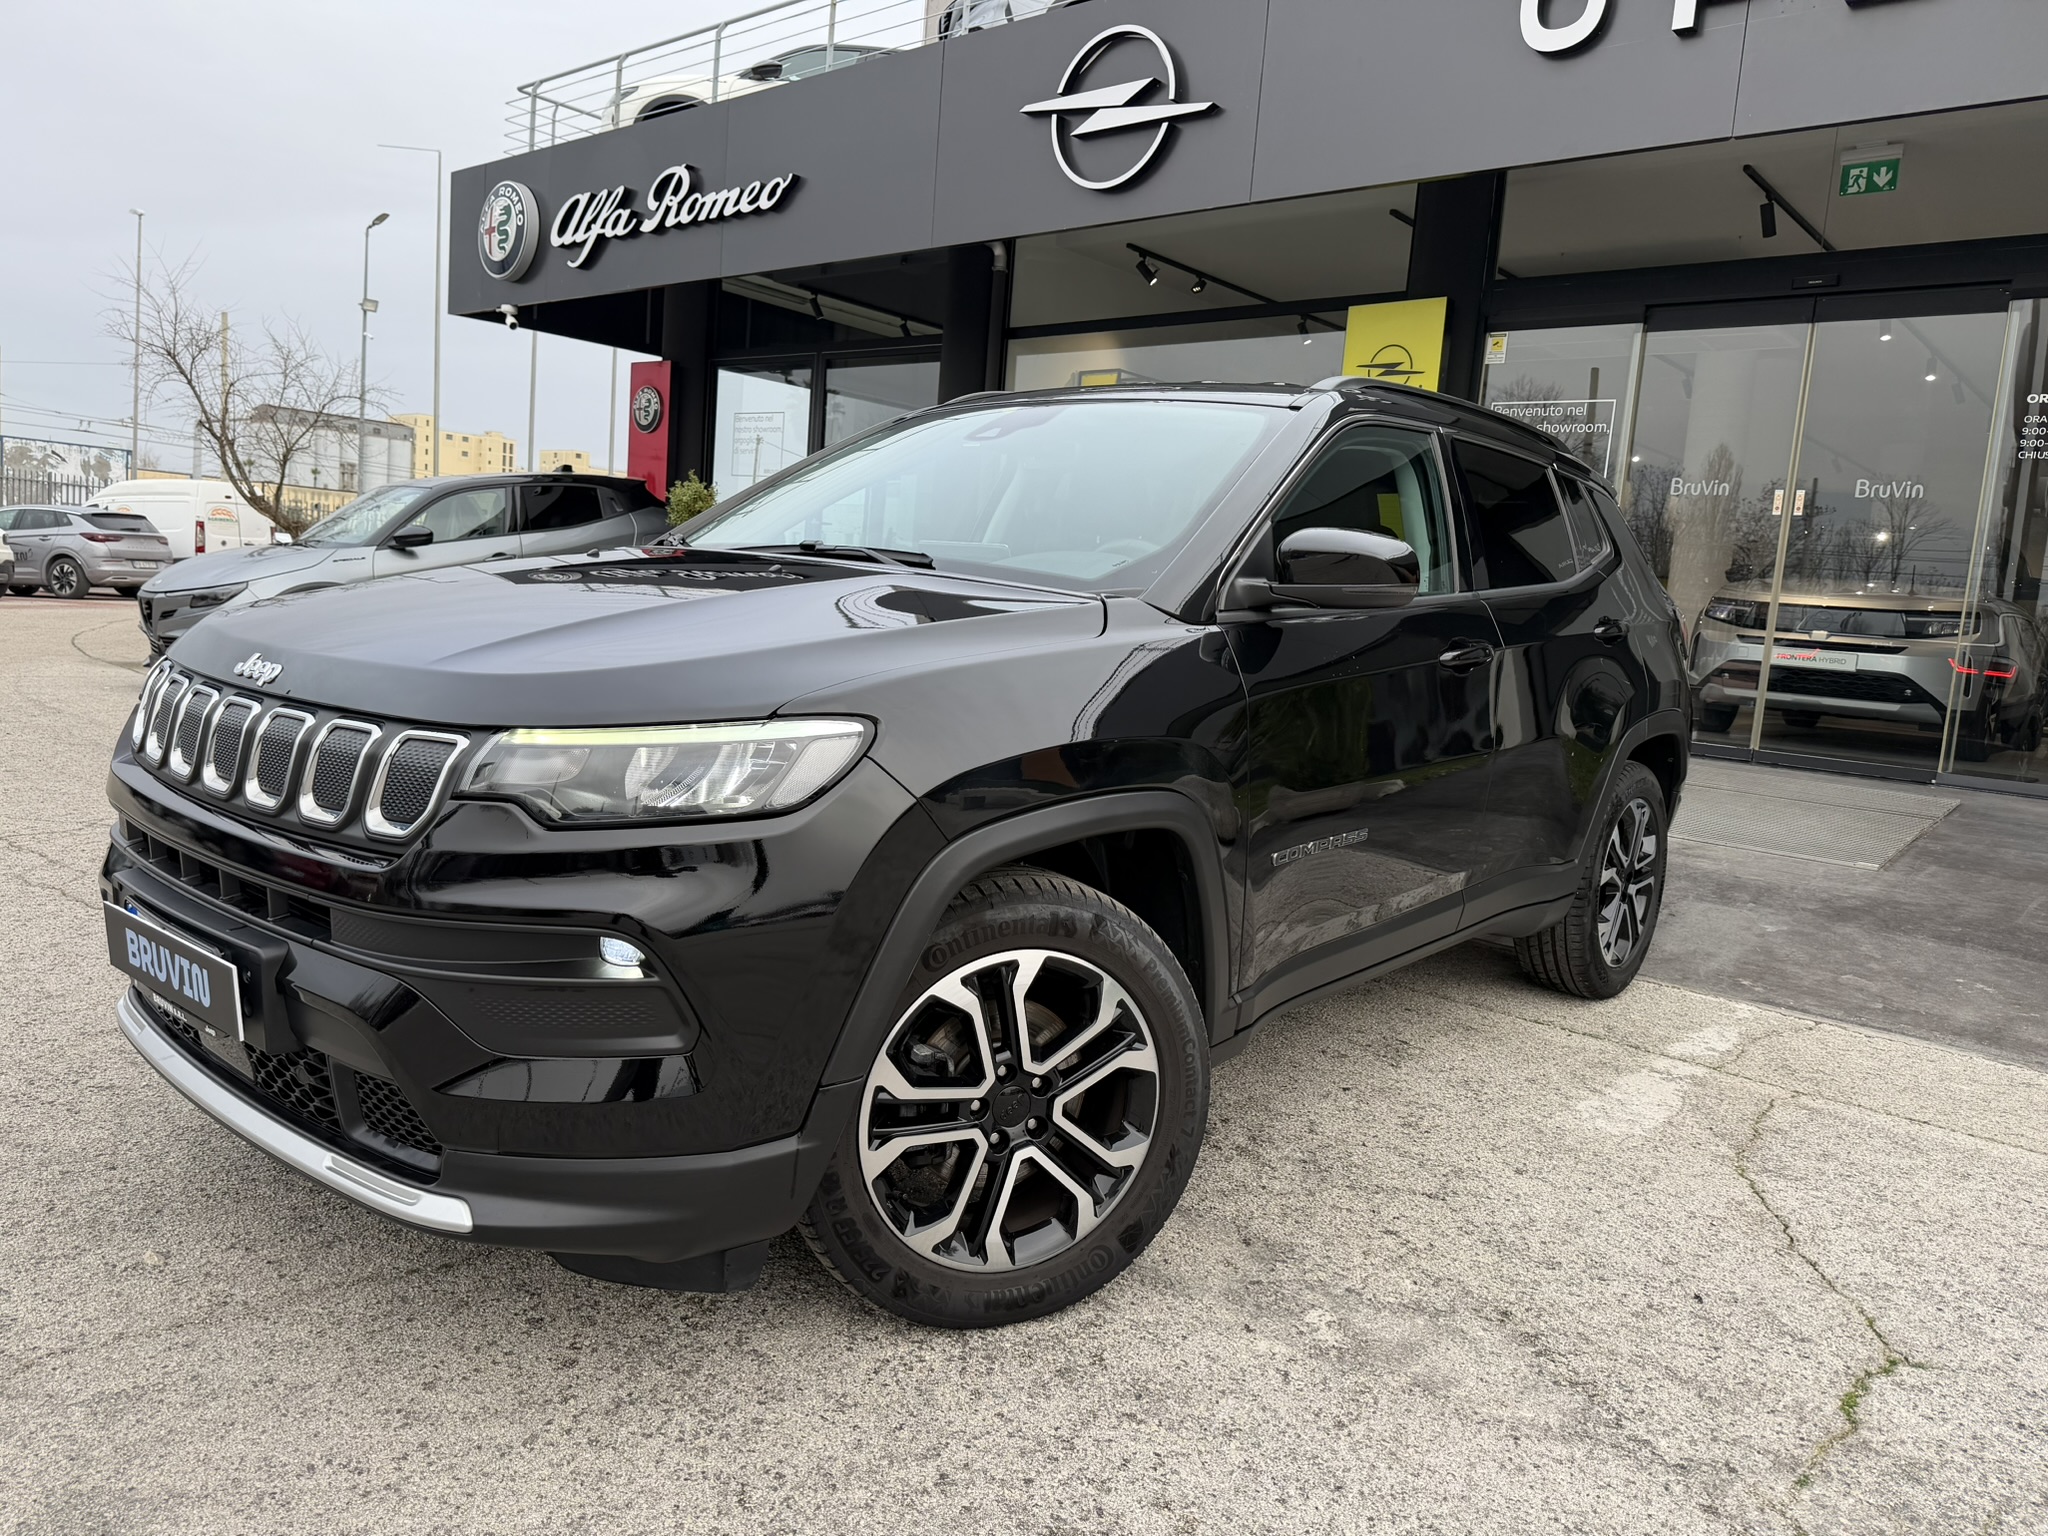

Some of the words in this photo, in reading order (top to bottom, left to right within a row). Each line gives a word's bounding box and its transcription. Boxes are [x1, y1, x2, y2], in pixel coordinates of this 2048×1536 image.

[499, 186, 524, 226] ROMEO
[550, 185, 637, 268] Alfa
[640, 163, 793, 232] Romeo
[1494, 405, 1563, 417] Benvenuto
[1567, 402, 1588, 416] nel
[1536, 421, 1611, 435] showroom,
[1670, 477, 1730, 497] BruVin
[1854, 478, 1925, 499] BruVin
[233, 652, 283, 687] Jeep
[1818, 656, 1847, 665] HYBRID
[1271, 827, 1369, 867] COMPASS
[921, 912, 1059, 973] Continental
[125, 926, 211, 1009] BRUVIN
[1141, 953, 1199, 1120] PremiumContact
[983, 1240, 1118, 1314] Continental
